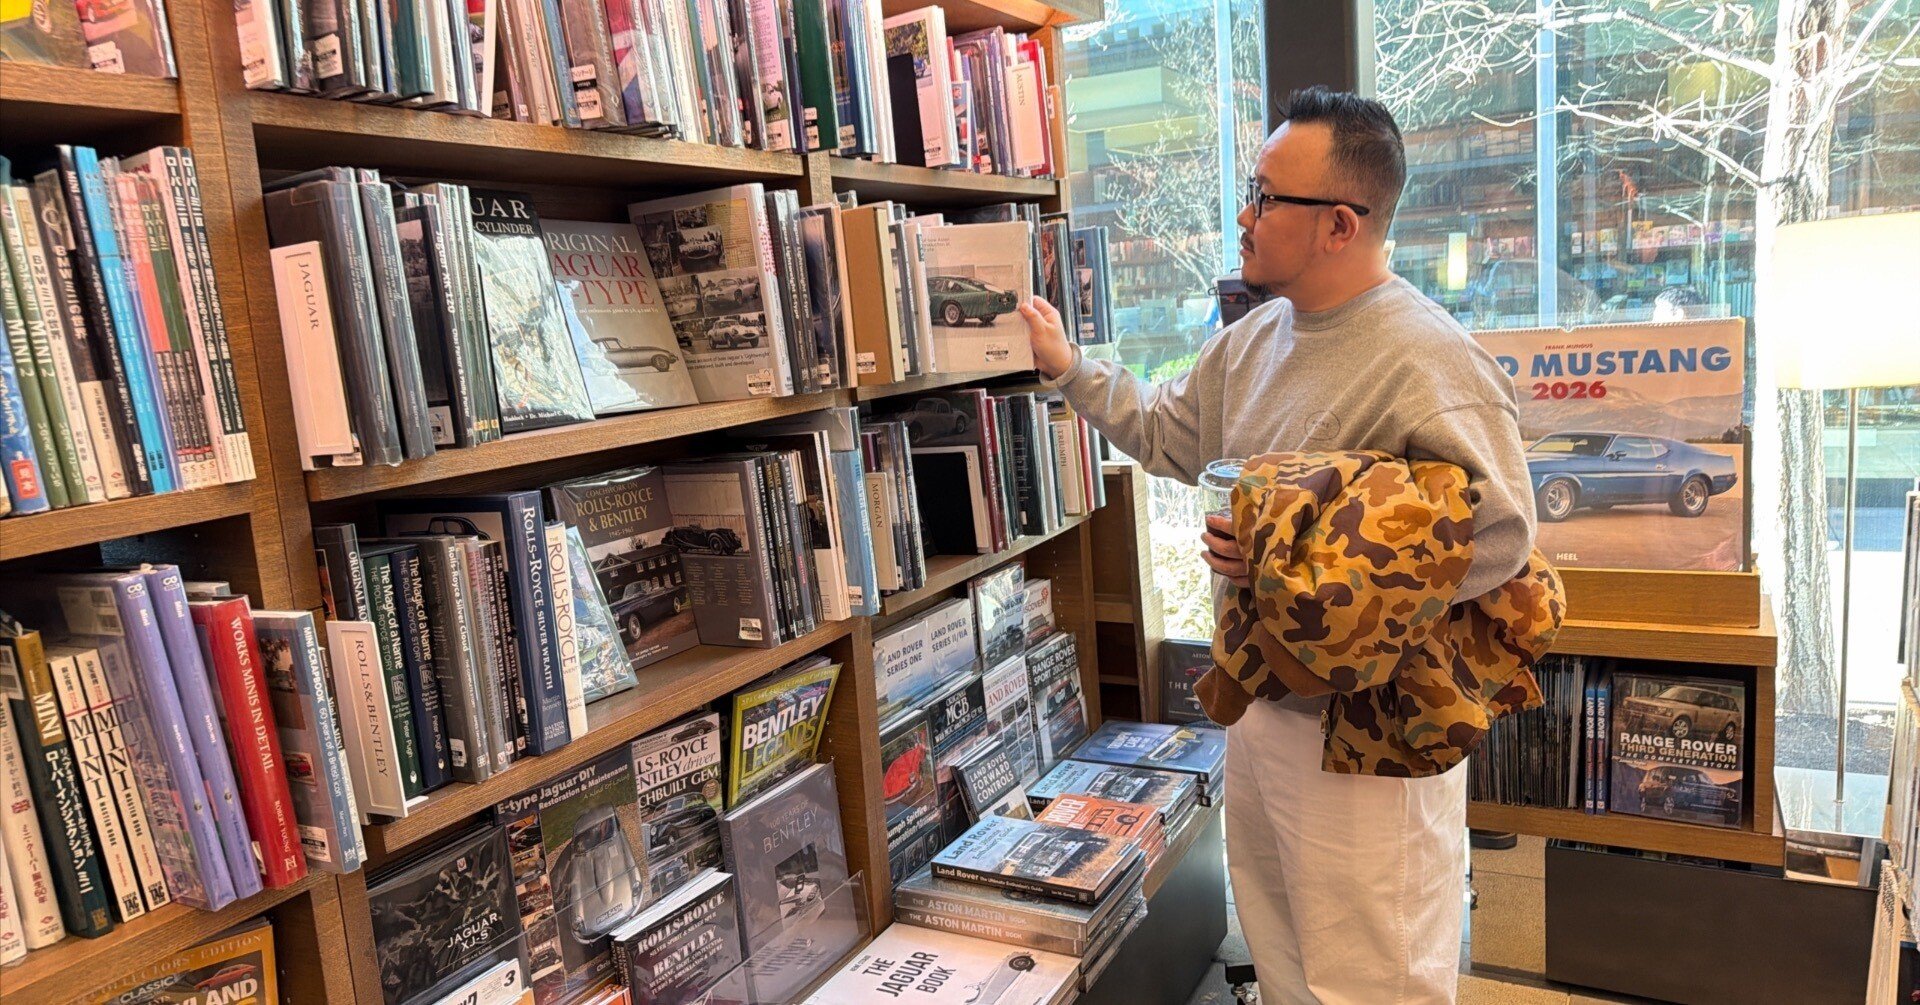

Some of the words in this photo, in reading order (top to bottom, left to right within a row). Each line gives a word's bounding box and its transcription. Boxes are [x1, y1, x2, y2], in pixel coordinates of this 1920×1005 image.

[1016, 74, 1026, 106] AUSTIN
[435, 230, 449, 272] Jaguar
[552, 253, 646, 278] AGUAR
[442, 272, 451, 289] XK
[298, 261, 320, 331] JAGUAR
[445, 291, 455, 314] 120
[6, 319, 30, 364] MINI
[20, 367, 34, 378] 2
[27, 319, 52, 364] MINI
[40, 367, 54, 378] 2
[451, 328, 459, 344] Chas
[454, 346, 462, 367] Parker
[1530, 346, 1731, 378] MUSTANG
[457, 375, 467, 395] Philip
[1531, 381, 1607, 400] 2026
[461, 396, 470, 417] Porter
[1057, 429, 1067, 467] TRIUMPH
[585, 484, 626, 498] COACHWORK
[748, 470, 760, 514] COACHWORK
[782, 465, 796, 503] BENTLEY
[576, 487, 654, 518] ROLLS-ROYCE
[871, 483, 883, 528] MORGAN
[588, 518, 599, 532] &
[600, 505, 648, 529] BENTLEY
[408, 556, 420, 577] The
[521, 506, 547, 608] ROLLS-ROYCE
[1556, 553, 1578, 561] HEEL
[346, 550, 366, 602] ORIGINAL
[379, 563, 392, 584] The
[379, 584, 395, 615] Magic
[408, 577, 425, 608] Magic
[548, 542, 577, 668] ROLLS-ROYCE
[140, 609, 150, 627] Mini
[174, 601, 184, 618] Mini
[369, 566, 379, 582] THE
[381, 644, 393, 671] STORY
[399, 559, 409, 575] THE
[410, 635, 422, 662] STORY
[231, 617, 250, 666] WORKS
[302, 626, 313, 647] MINI
[536, 610, 548, 645] SILVER
[930, 627, 946, 640] LAND
[947, 618, 966, 632] ROVER
[391, 637, 403, 669] Name
[419, 630, 432, 660] Name
[886, 651, 900, 665] AND
[902, 640, 923, 656] ROVER
[1032, 657, 1054, 675] RANGE
[1055, 643, 1076, 661] ROVER
[305, 647, 325, 703] SCRAPBOOK
[540, 646, 553, 690] WRAITH
[886, 659, 907, 677] SERIES
[909, 652, 922, 666] ONE
[1033, 671, 1052, 686] SPORT
[1052, 655, 1077, 676] 2005-2013
[241, 668, 260, 706] MINIS
[1168, 682, 1188, 691] THE
[34, 692, 62, 739] MINI
[251, 708, 264, 723] IN
[318, 707, 327, 719] 60
[355, 639, 388, 777] ROLLS&BENTLEY
[945, 696, 970, 726] MGB
[1586, 697, 1594, 716] LAND
[1597, 697, 1605, 716] LAND
[319, 720, 330, 739] years
[402, 720, 410, 737] Peter
[431, 714, 440, 732] Peter
[743, 693, 825, 751] BENTLEY
[1586, 717, 1594, 739] ROVER
[1597, 717, 1605, 739] ROVER
[95, 708, 131, 793] MINI
[255, 726, 275, 774] DETAIL
[325, 740, 333, 749] of
[404, 739, 414, 757] Pugh
[433, 733, 443, 751] Pugh
[637, 736, 708, 775] LS-ROYCE
[741, 715, 819, 779] LEGENDS
[1620, 732, 1675, 748] RANGE
[1681, 739, 1737, 755] ROVER
[1620, 742, 1655, 754] THIRD
[1659, 747, 1737, 764] GENERATION
[68, 713, 106, 800] MINI
[327, 757, 339, 781] British
[970, 764, 986, 783] LAND
[987, 751, 1006, 770] ROVER
[1644, 754, 1697, 765] COMPLETE
[1703, 761, 1737, 769] STORY
[636, 761, 682, 790] NTLEY
[683, 752, 716, 772] driver
[973, 760, 1010, 793] FORWARD
[332, 782, 342, 797] icon
[497, 793, 538, 815] E-type
[540, 776, 577, 800] Jaguar
[579, 765, 596, 782] DIY
[538, 788, 580, 810] Restoration
[588, 764, 628, 788] Maintenance
[639, 777, 688, 808] CHBUILT
[691, 766, 718, 785] GEM
[977, 771, 1014, 804] CONTROLS
[274, 800, 286, 828] ROBERT
[781, 806, 801, 823] YEARS
[801, 800, 810, 809] OF
[278, 828, 291, 853] YOUNG
[763, 806, 819, 854] BENTLEY
[944, 839, 973, 860] Land
[971, 818, 1000, 843] Rover
[149, 885, 166, 901] TAC
[936, 866, 955, 876] Land
[956, 870, 980, 881] Rover
[1030, 884, 1043, 892] Guide
[123, 895, 140, 912] TAC
[912, 898, 924, 906] THE
[927, 900, 962, 915] ASTON
[964, 907, 1006, 922] MARTIN
[447, 913, 498, 949] JAGUAR
[637, 891, 725, 955] ROLLS-ROYCE
[909, 913, 922, 921] THE
[925, 915, 960, 930] ASTON
[961, 921, 1001, 937] MARTIN
[1005, 931, 1023, 940] BOOK
[461, 931, 490, 952] XJ-S
[653, 926, 716, 977] BENTLEY
[503, 970, 516, 987] 3
[862, 957, 896, 977] THE
[876, 951, 939, 998] JAGUAR
[915, 966, 957, 994] BOOK
[120, 975, 176, 1003] CLASSIC
